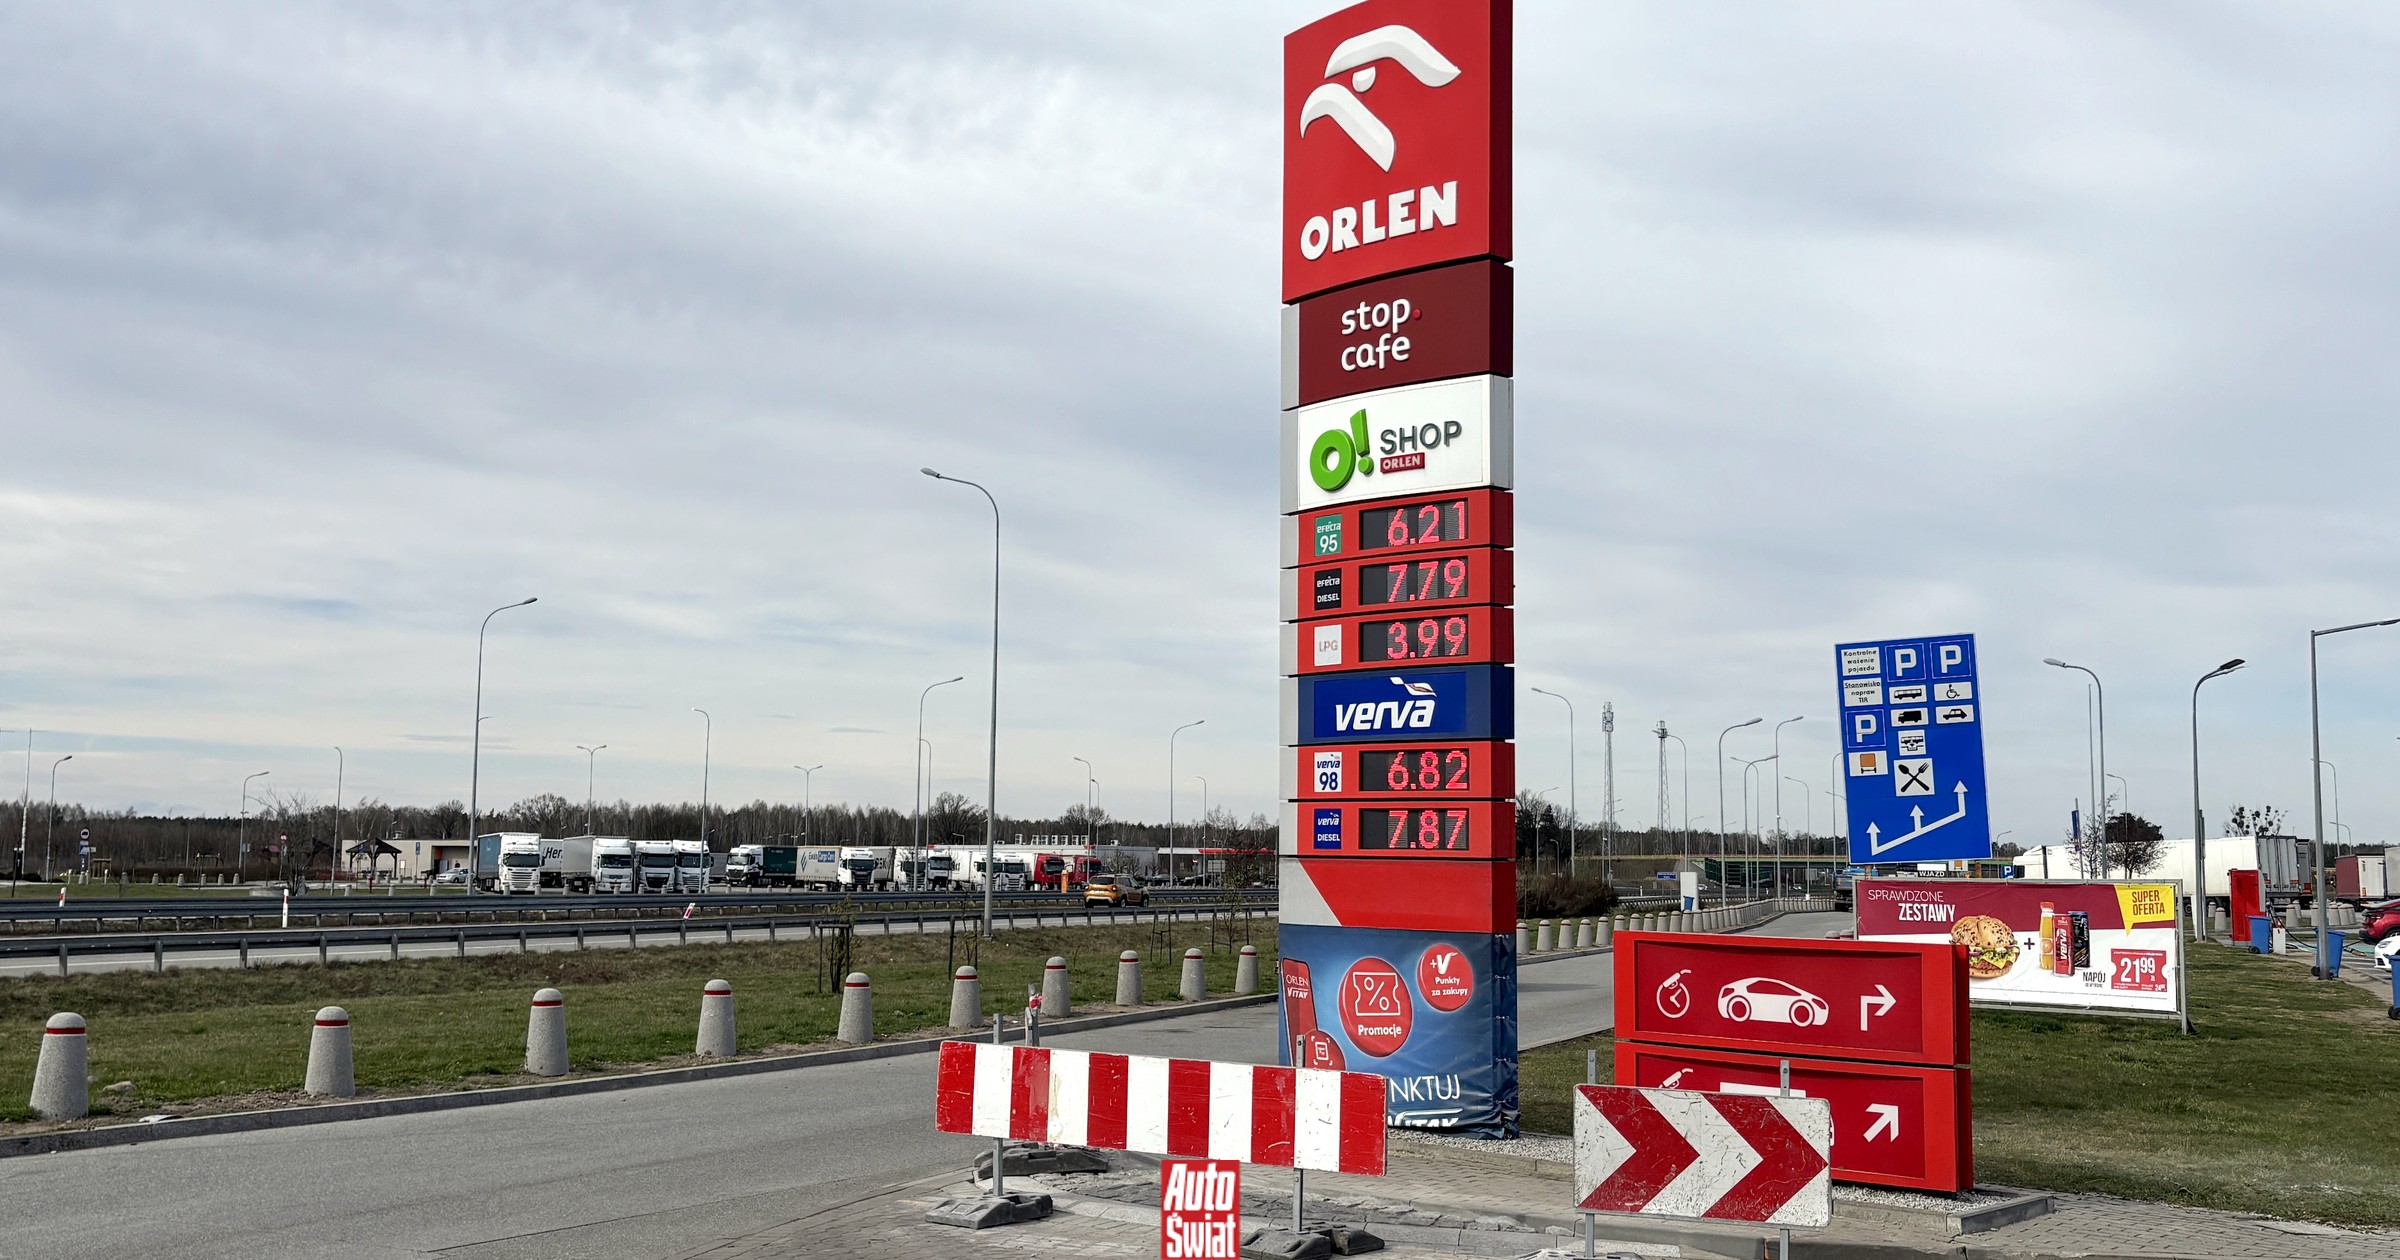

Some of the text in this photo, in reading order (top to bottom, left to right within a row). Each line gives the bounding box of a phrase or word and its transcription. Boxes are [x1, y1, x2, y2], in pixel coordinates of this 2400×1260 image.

[1300, 180, 1458, 260] ORLEN
[1341, 332, 1410, 371] cafe
[1310, 408, 1462, 492] O! SHOP
[1382, 455, 1421, 470] ORLEN
[1388, 501, 1465, 546] 6.21
[1320, 534, 1338, 552] 95
[1388, 558, 1466, 602] 7.79
[1317, 593, 1340, 603] DIESEL
[1319, 640, 1338, 652] LPG
[1388, 616, 1466, 660] 3.99
[1894, 648, 1917, 676] P
[1940, 644, 1962, 673] P
[1336, 700, 1436, 731] verva
[1855, 714, 1877, 743] P
[1317, 760, 1340, 768] verva
[1388, 750, 1468, 790] 6.82
[1320, 772, 1338, 790] 98
[1388, 810, 1468, 849] 7.87
[1868, 890, 1944, 902] SPRAWDZONE
[2132, 890, 2160, 903] SUPER
[1898, 903, 1956, 922] ZESTAWY
[2133, 902, 2165, 915] OFERTA
[1286, 975, 1309, 987] ORLEN
[1435, 976, 1460, 985] Punkty
[2083, 970, 2106, 983] NAPÓJ
[1287, 987, 1309, 998] VITAY
[1442, 987, 1468, 996] zakupy
[1358, 1024, 1402, 1037] Promocje
[1388, 1074, 1460, 1102] NKTUJ
